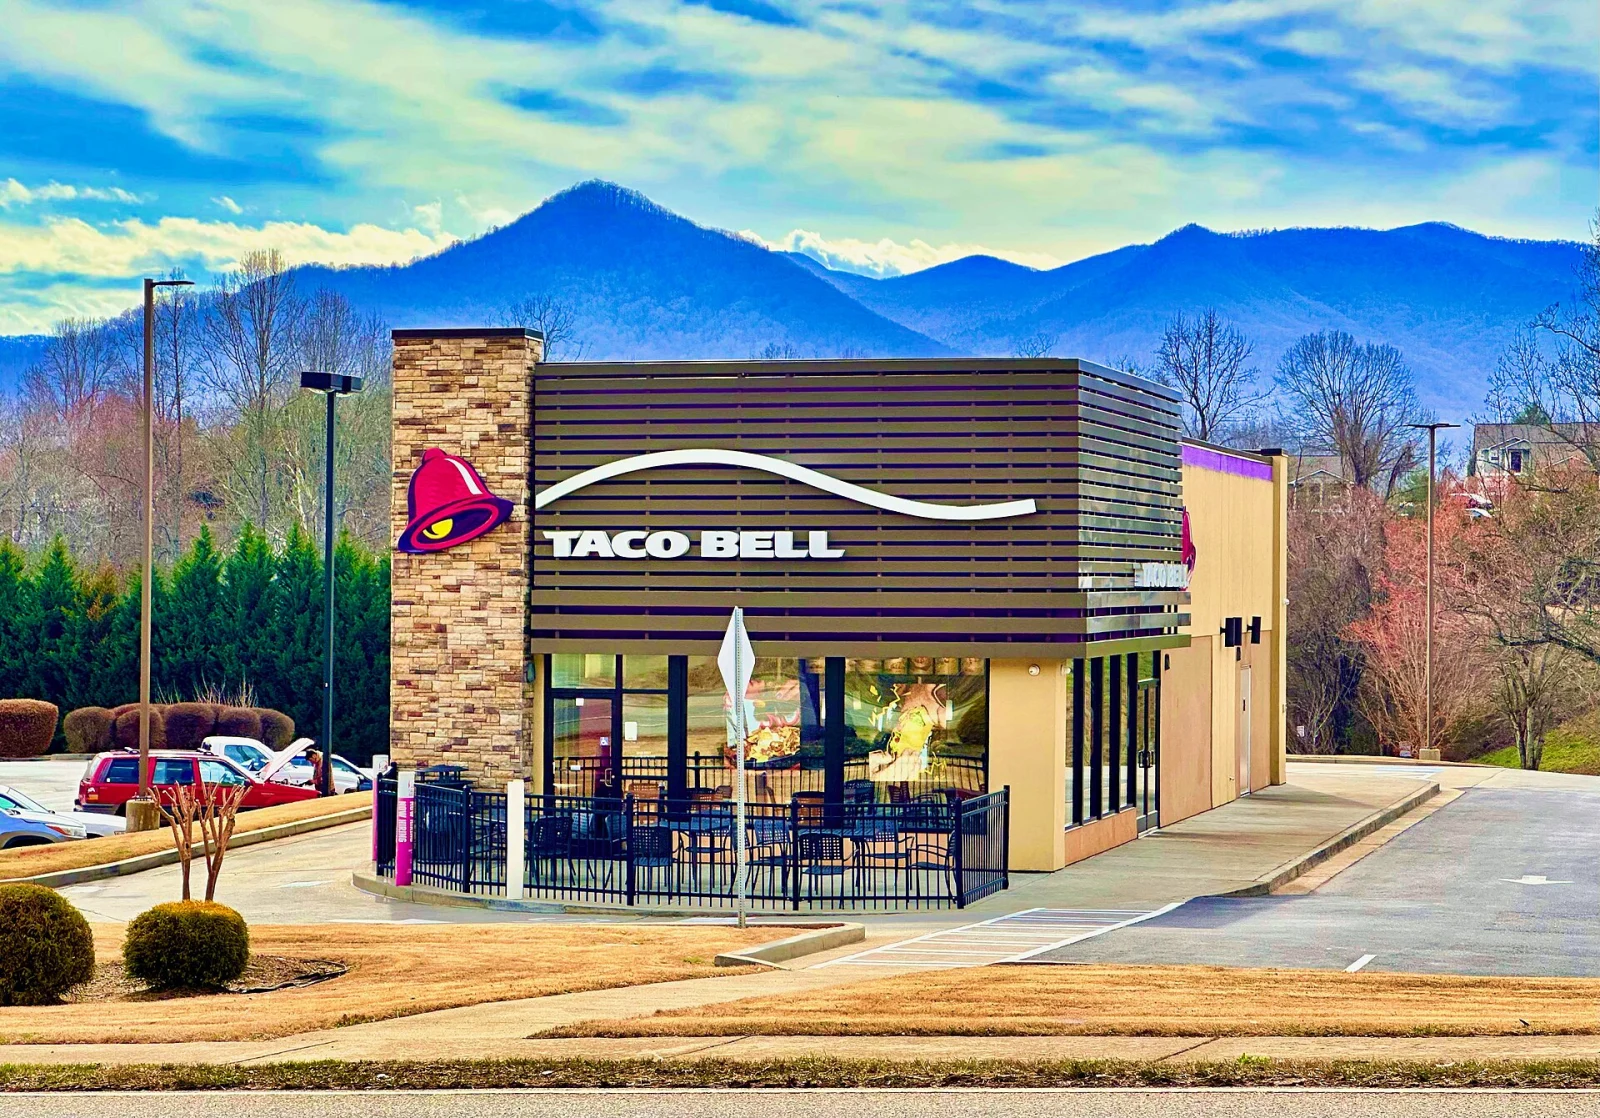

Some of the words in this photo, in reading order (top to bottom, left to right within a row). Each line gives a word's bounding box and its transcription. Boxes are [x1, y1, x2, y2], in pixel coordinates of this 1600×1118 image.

[543, 530, 690, 559] TACO
[700, 530, 845, 559] BELL
[398, 800, 407, 817] NOW
[398, 819, 407, 843] HIRING
